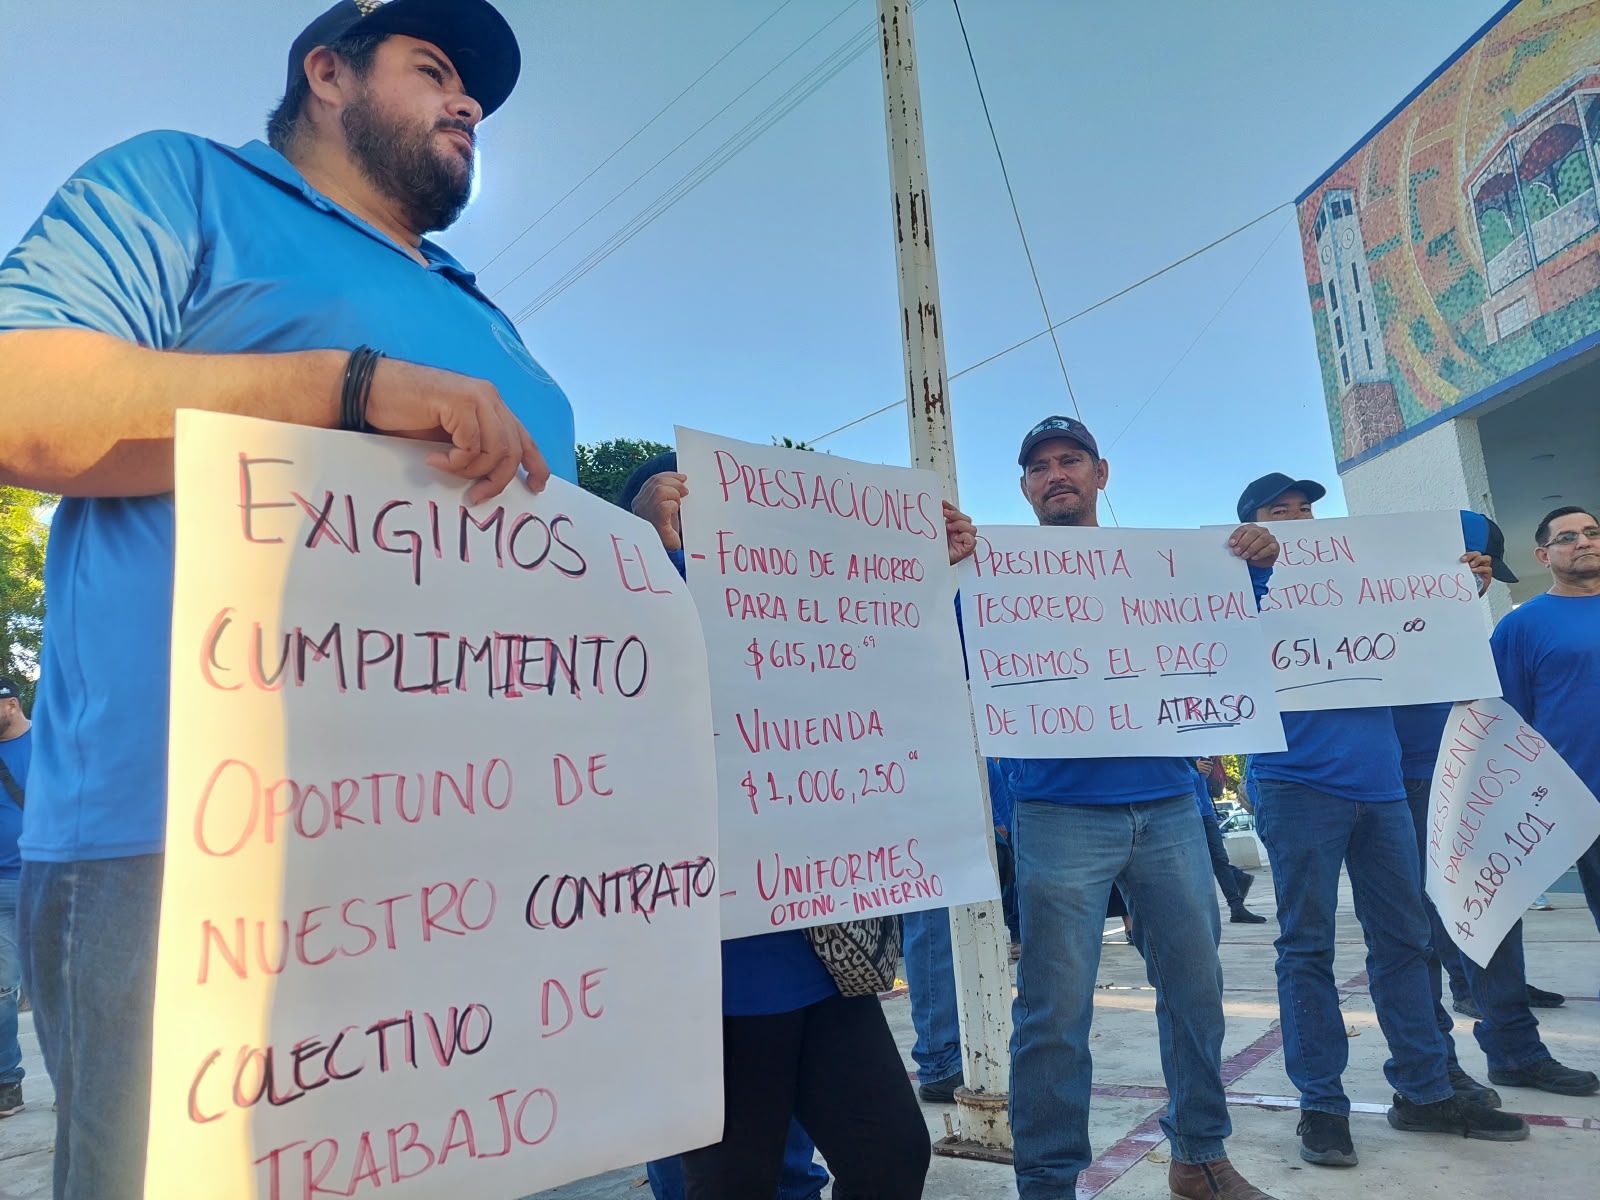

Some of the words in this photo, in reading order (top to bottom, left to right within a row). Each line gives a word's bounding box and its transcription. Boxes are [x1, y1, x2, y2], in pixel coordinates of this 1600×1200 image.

[237, 451, 587, 586] EXIGIMOS
[609, 532, 672, 595] EL
[713, 450, 937, 540] PRESTACIONES
[715, 529, 799, 576] FONDO
[809, 549, 835, 579] DE
[847, 553, 925, 583] AHORRO
[972, 535, 1133, 581] PRESIDENTA
[1157, 549, 1176, 577] Y
[1358, 572, 1473, 605] AHORROS
[725, 587, 788, 622] PARA
[798, 597, 829, 624] EL
[838, 592, 920, 629] RETIRO
[973, 592, 1104, 627] TESORERO
[1121, 591, 1258, 626] MUNICIPAL
[200, 606, 650, 700] CUMPLIMIENTO
[979, 646, 1090, 681] PEDIMOS
[1108, 647, 1147, 676] EL
[1156, 642, 1229, 677] PAGO
[735, 708, 884, 754] VIVIENDA
[986, 703, 1019, 736] DE
[1026, 703, 1095, 735] TODO
[1109, 703, 1144, 731] EL
[1157, 694, 1256, 726] ATRASO
[193, 758, 513, 857] OPORTUNO
[552, 753, 614, 806] DE
[1428, 706, 1503, 869] PRESIDENTA
[1443, 758, 1521, 884] PAGUENOS
[1503, 725, 1546, 763] LOS
[756, 838, 925, 901] UNIFORMES
[196, 877, 499, 985] NUESTRO
[524, 855, 716, 931] CONTRATO
[187, 1002, 493, 1124] COLECTIVO
[541, 967, 609, 1039] DE
[253, 1087, 558, 1200] TRABAJO
